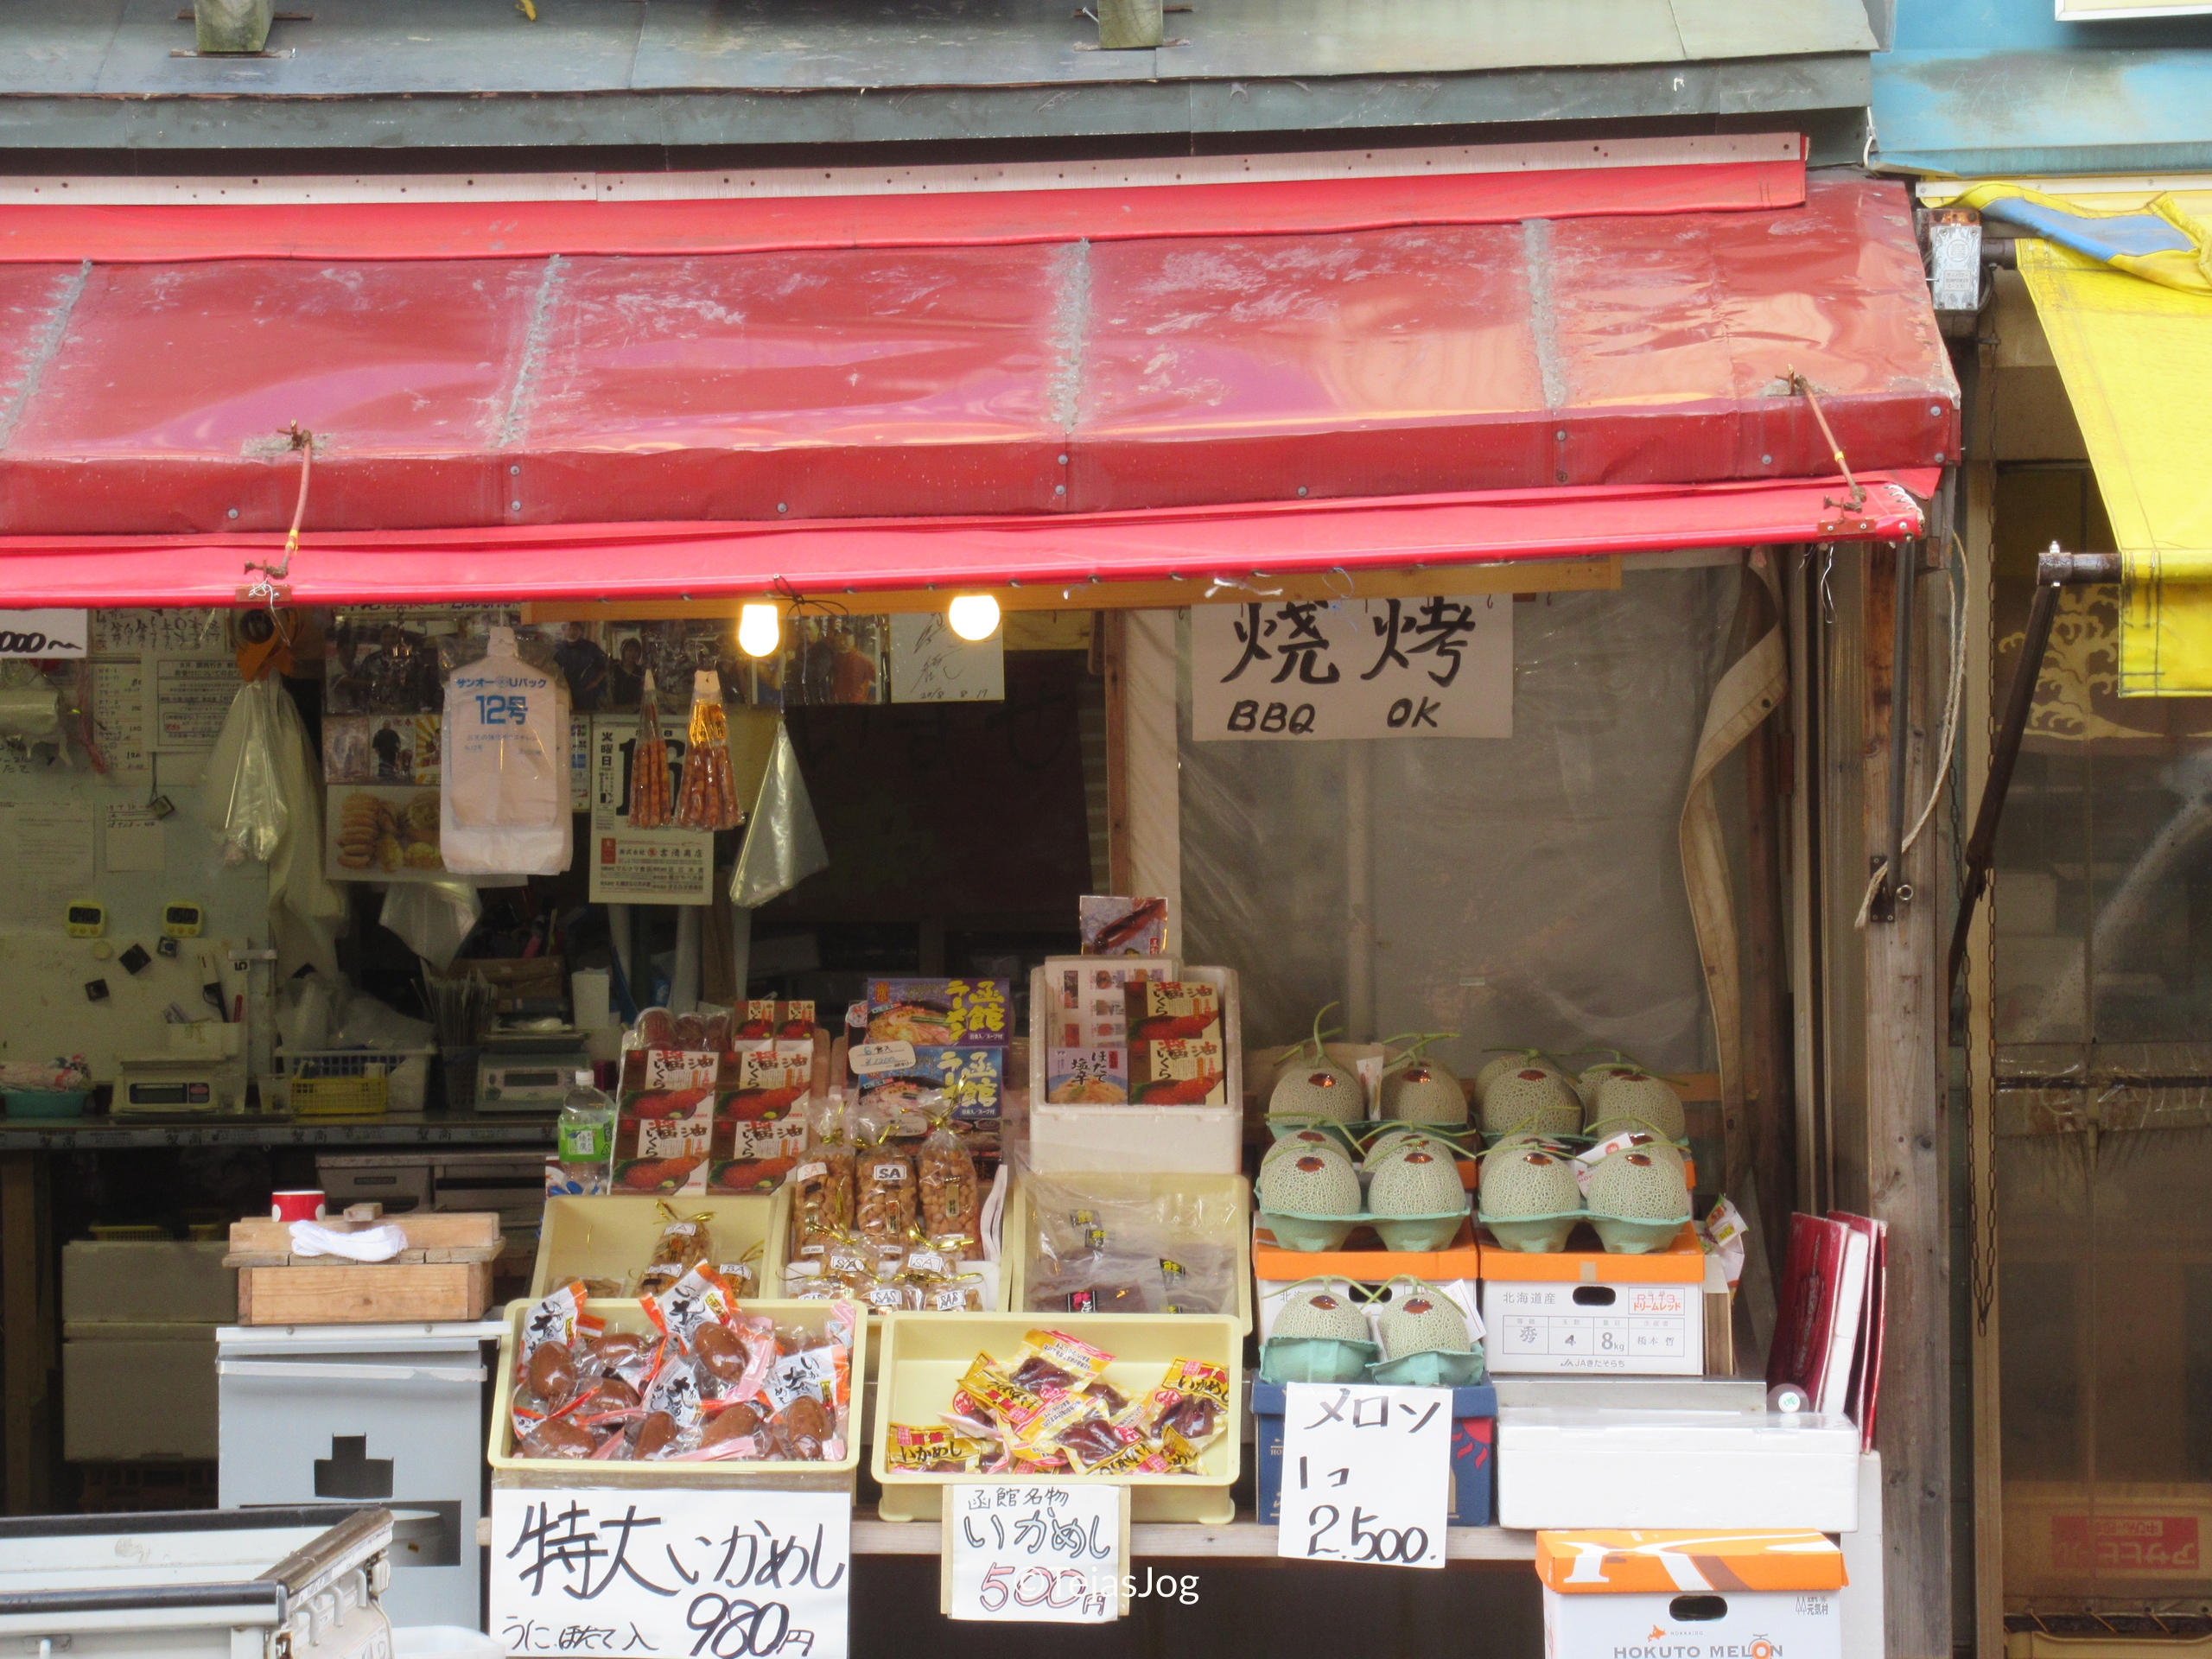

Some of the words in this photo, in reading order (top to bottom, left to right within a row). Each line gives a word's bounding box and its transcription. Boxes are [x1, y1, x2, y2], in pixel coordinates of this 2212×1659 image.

[456, 677, 495, 689] サンオー
[475, 695, 529, 725] 12号
[1227, 699, 1316, 734] BBQ
[1386, 696, 1441, 728] OK
[879, 1166, 901, 1179] SA
[910, 1257, 934, 1268] SA
[1503, 1291, 1556, 1306] 北海道産
[1633, 1302, 1681, 1312] ドリームレッド
[1601, 1332, 1625, 1352] 8kg
[1303, 1388, 1441, 1433] メロン
[900, 1440, 963, 1462] いかめし
[967, 1487, 1070, 1511] 函館名物
[963, 1506, 1111, 1560] いかめし
[979, 1561, 1108, 1616] 500円
[1807, 1603, 1829, 1616] 元気村
[686, 1592, 815, 1659] 980円
[1613, 1645, 1701, 1659] HOKUTO
[1709, 1642, 1783, 1659] MELON
